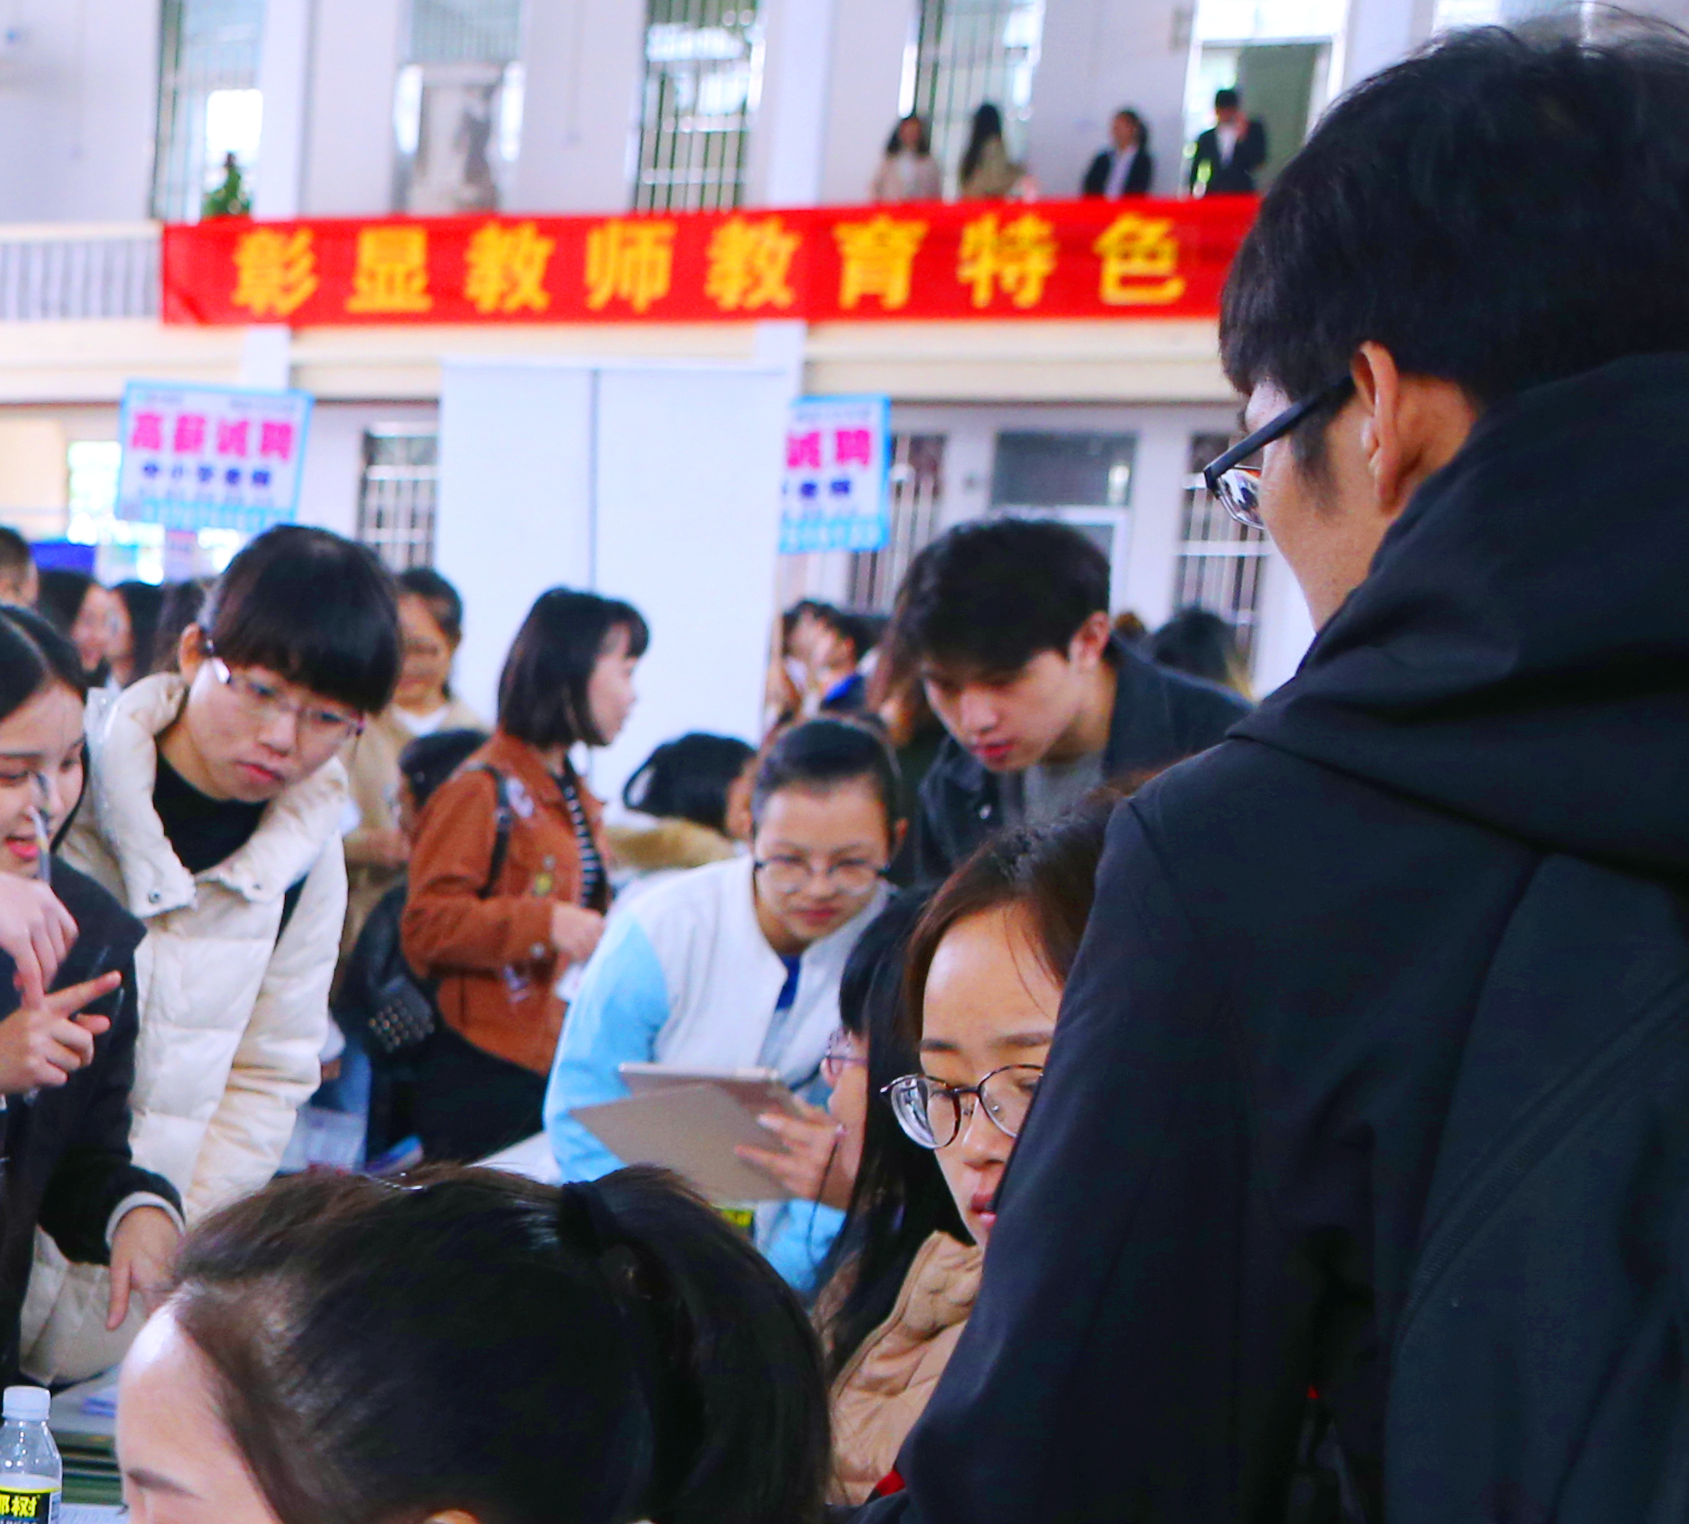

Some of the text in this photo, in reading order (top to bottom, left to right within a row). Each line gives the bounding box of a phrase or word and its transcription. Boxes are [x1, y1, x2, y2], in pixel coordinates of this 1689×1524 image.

[231, 216, 1186, 316] 彰显教师教育特色
[132, 412, 294, 462] 高薪诚聘
